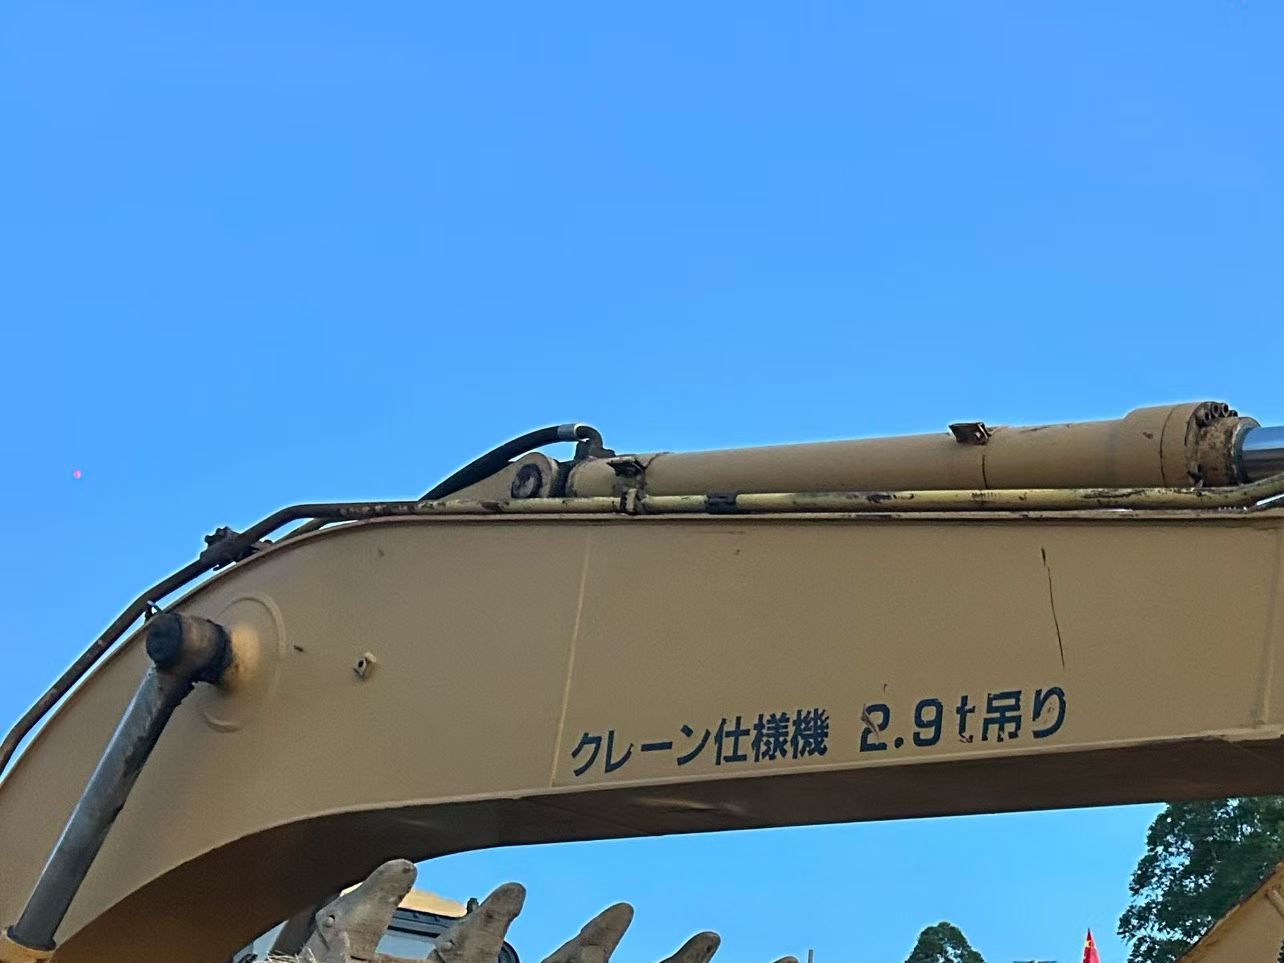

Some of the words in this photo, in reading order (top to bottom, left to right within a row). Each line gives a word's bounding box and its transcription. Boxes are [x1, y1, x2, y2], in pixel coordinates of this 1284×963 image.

[571, 708, 830, 777] クレーン仕様機
